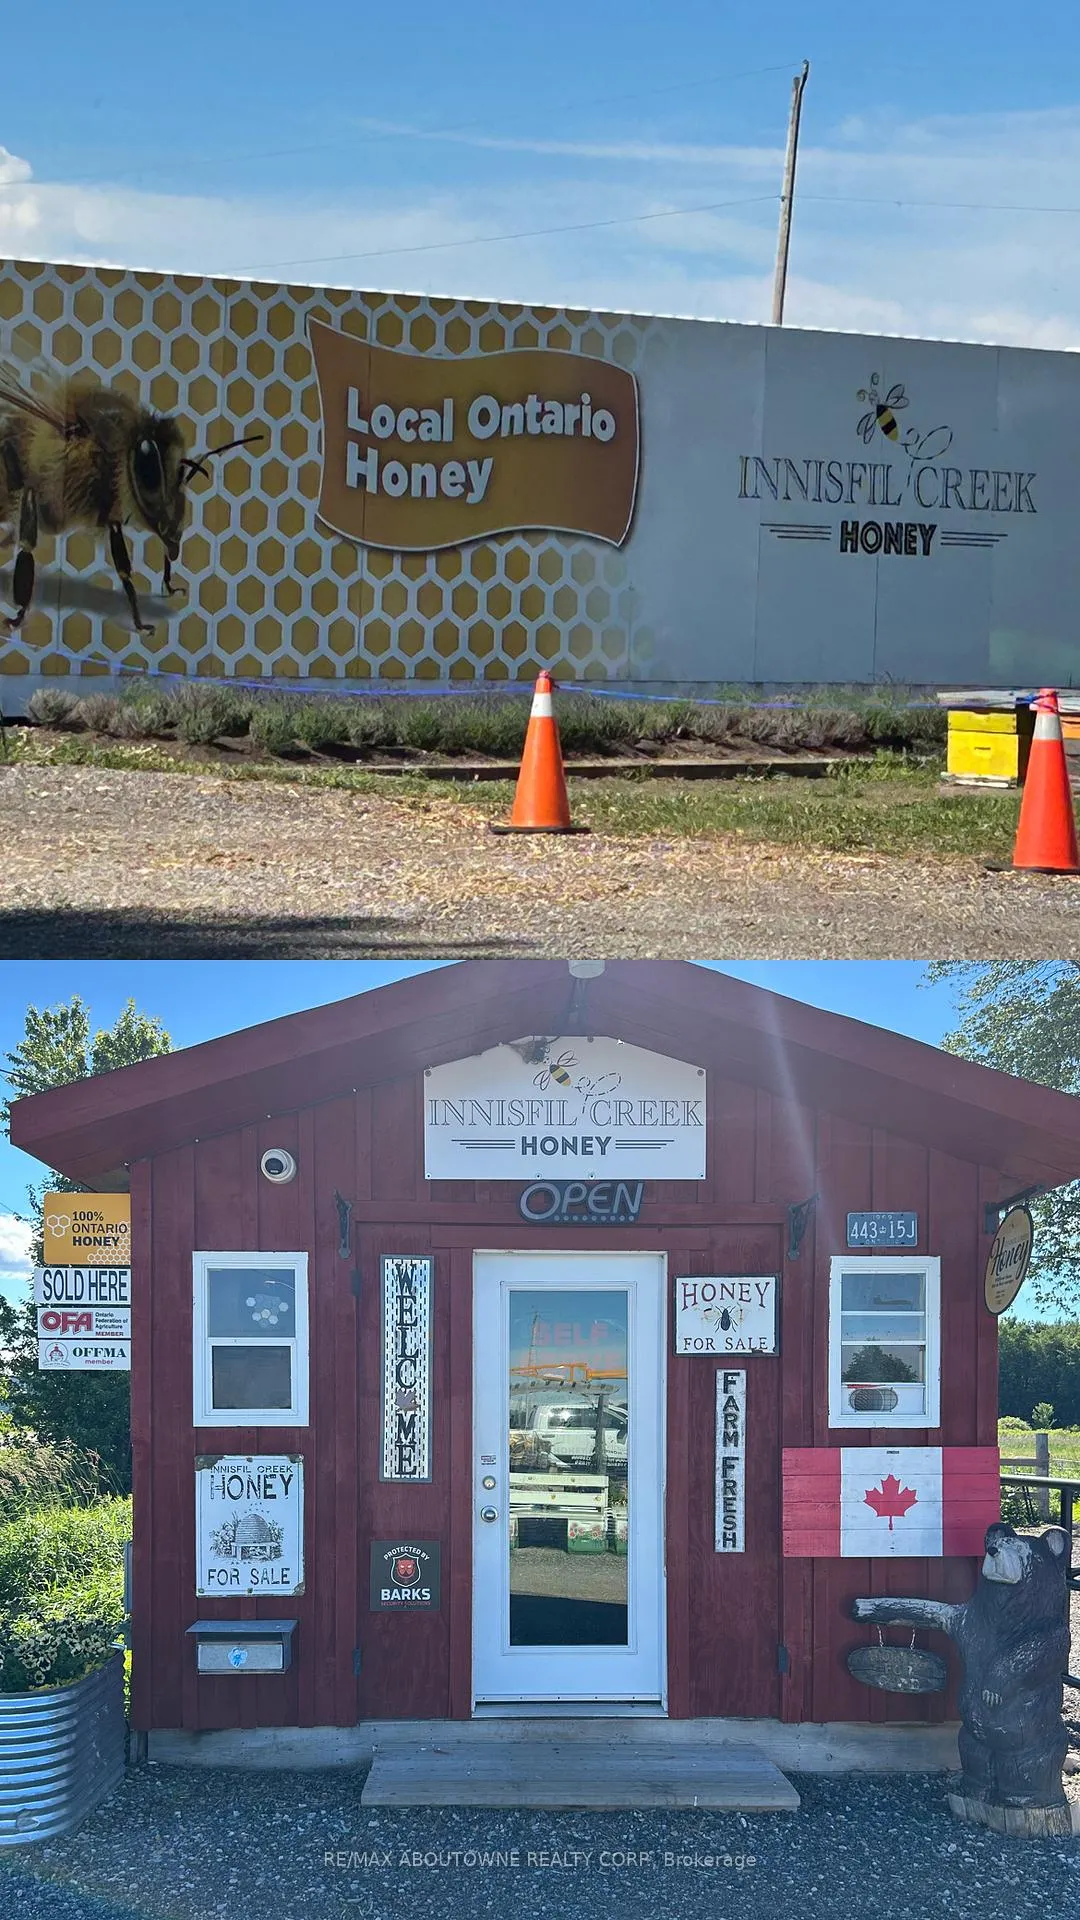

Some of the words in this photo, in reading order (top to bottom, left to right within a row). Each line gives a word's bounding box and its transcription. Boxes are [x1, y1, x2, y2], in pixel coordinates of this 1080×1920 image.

[346, 386, 454, 442] Local
[467, 392, 616, 442] Ontario
[345, 440, 494, 504] Honey
[737, 455, 902, 506] INNISFIL
[912, 465, 1037, 513] CREEK
[839, 520, 938, 556] HONEY
[428, 1099, 578, 1126] INNISFIL
[589, 1099, 704, 1127] CREEK
[521, 1136, 612, 1156] HONEY
[519, 1182, 645, 1221] OPEN
[72, 1211, 104, 1222] 100%
[72, 1223, 128, 1234] ONTARIO
[72, 1236, 120, 1247] HONEY
[850, 1221, 878, 1239] 443
[889, 1220, 915, 1239] 15J
[988, 1236, 1029, 1281] Honey
[43, 1269, 84, 1301] SOLD
[88, 1270, 128, 1301] HERE
[682, 1282, 770, 1312] HONEY
[41, 1311, 94, 1335] OFA
[72, 1347, 126, 1358] OFFMA
[683, 1337, 716, 1351] FOR
[724, 1337, 768, 1351] SALE
[722, 1372, 740, 1447] FARM
[210, 1465, 251, 1474] INNISFIL
[256, 1465, 294, 1474] CREEK
[210, 1474, 294, 1501] HONEY
[721, 1456, 740, 1549] FRESH
[383, 1545, 421, 1560] PROTECTED
[420, 1551, 430, 1560] BY
[207, 1568, 240, 1586] FOR
[250, 1567, 291, 1586] SALE
[381, 1588, 431, 1601] BARKS
